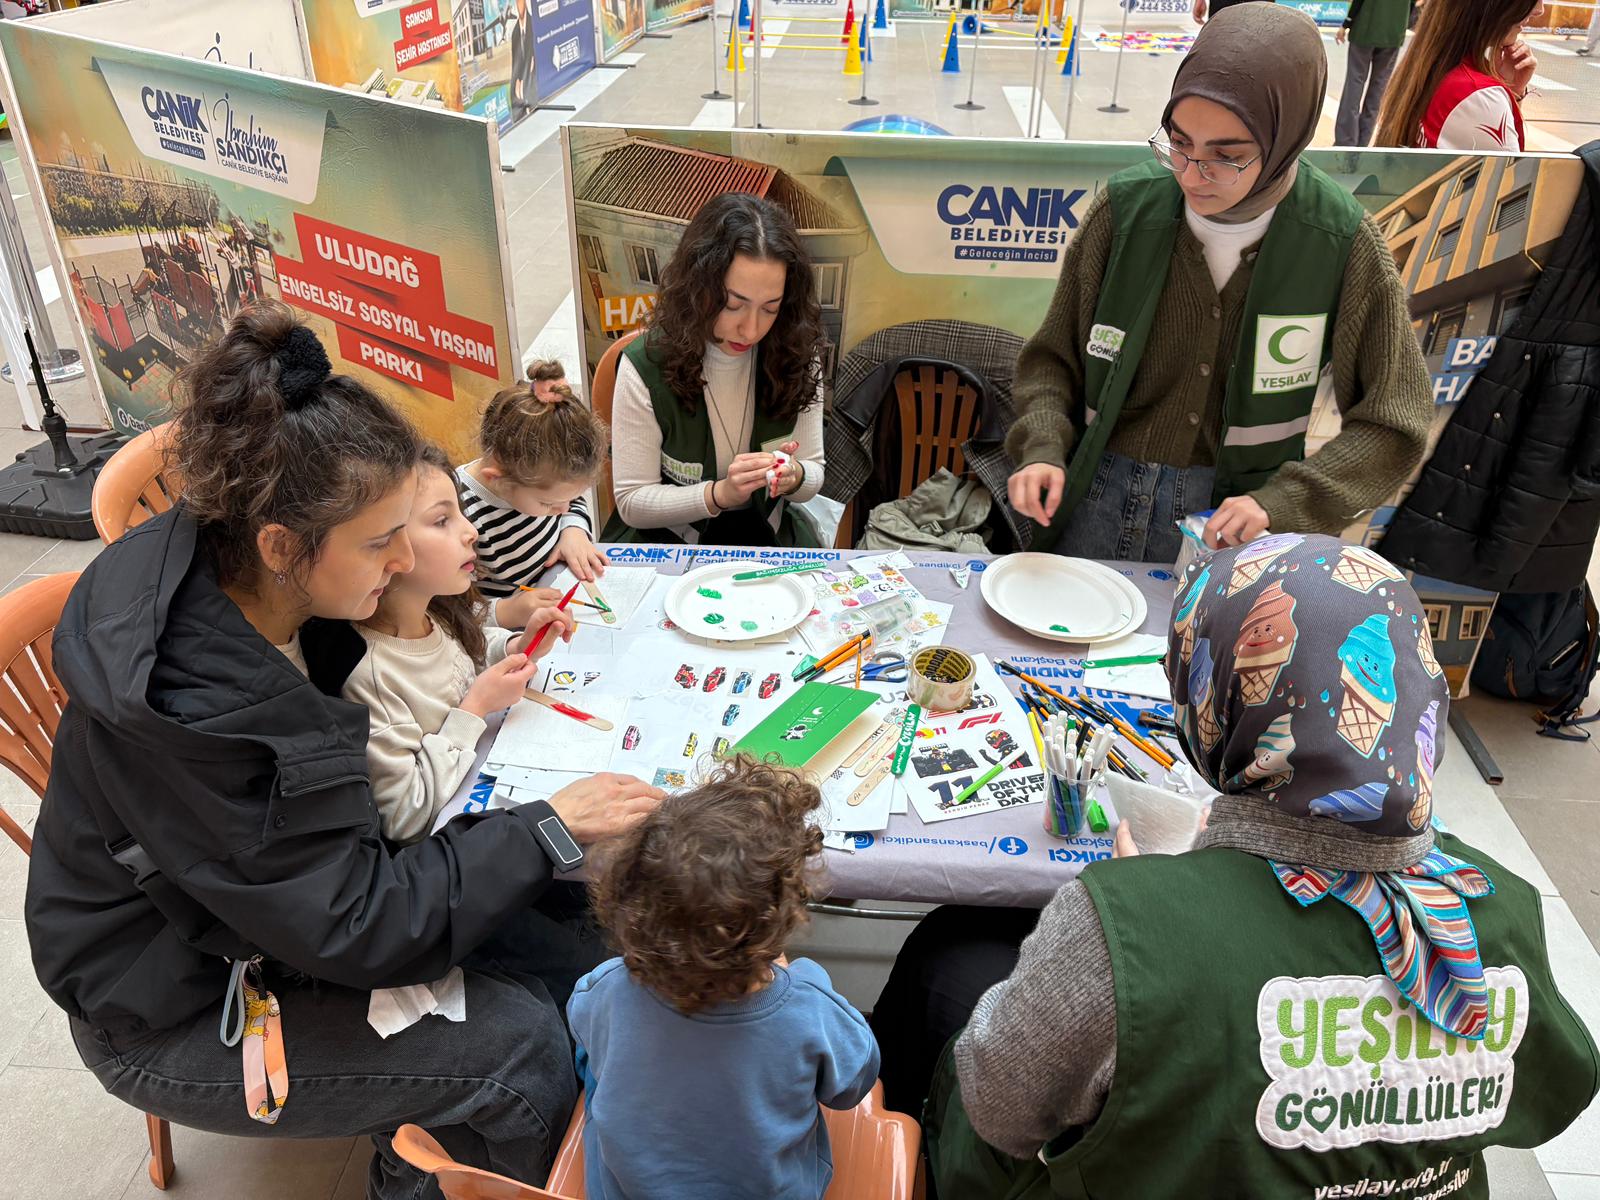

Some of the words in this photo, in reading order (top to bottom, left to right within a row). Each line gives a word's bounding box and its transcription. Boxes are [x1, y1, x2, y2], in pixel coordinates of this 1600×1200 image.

[405, 8, 433, 29] SAMSUN
[418, 28, 451, 56] HASTANESİ
[213, 93, 278, 152] İbrahim
[216, 137, 288, 174] SANDIKÇI
[315, 233, 420, 288] ULUDAĞ
[960, 249, 1020, 261] #Geleceğin
[279, 273, 356, 317] ENGELSİZ
[358, 301, 426, 342] SOSYAL
[428, 324, 495, 367] YAŞAM
[1093, 328, 1121, 348] YEŞ
[360, 342, 423, 382] PARKI
[1090, 344, 1118, 358] GÖNÜ
[760, 551, 840, 561] SANDIKÇI
[993, 790, 1017, 800] OF
[1017, 783, 1045, 796] TH
[997, 794, 1030, 808] DAY
[1065, 837, 1114, 849] aşkanı
[1276, 986, 1516, 1079] YEŞİLY
[1275, 1073, 1505, 1133] GÖNÜLLÜLERİ
